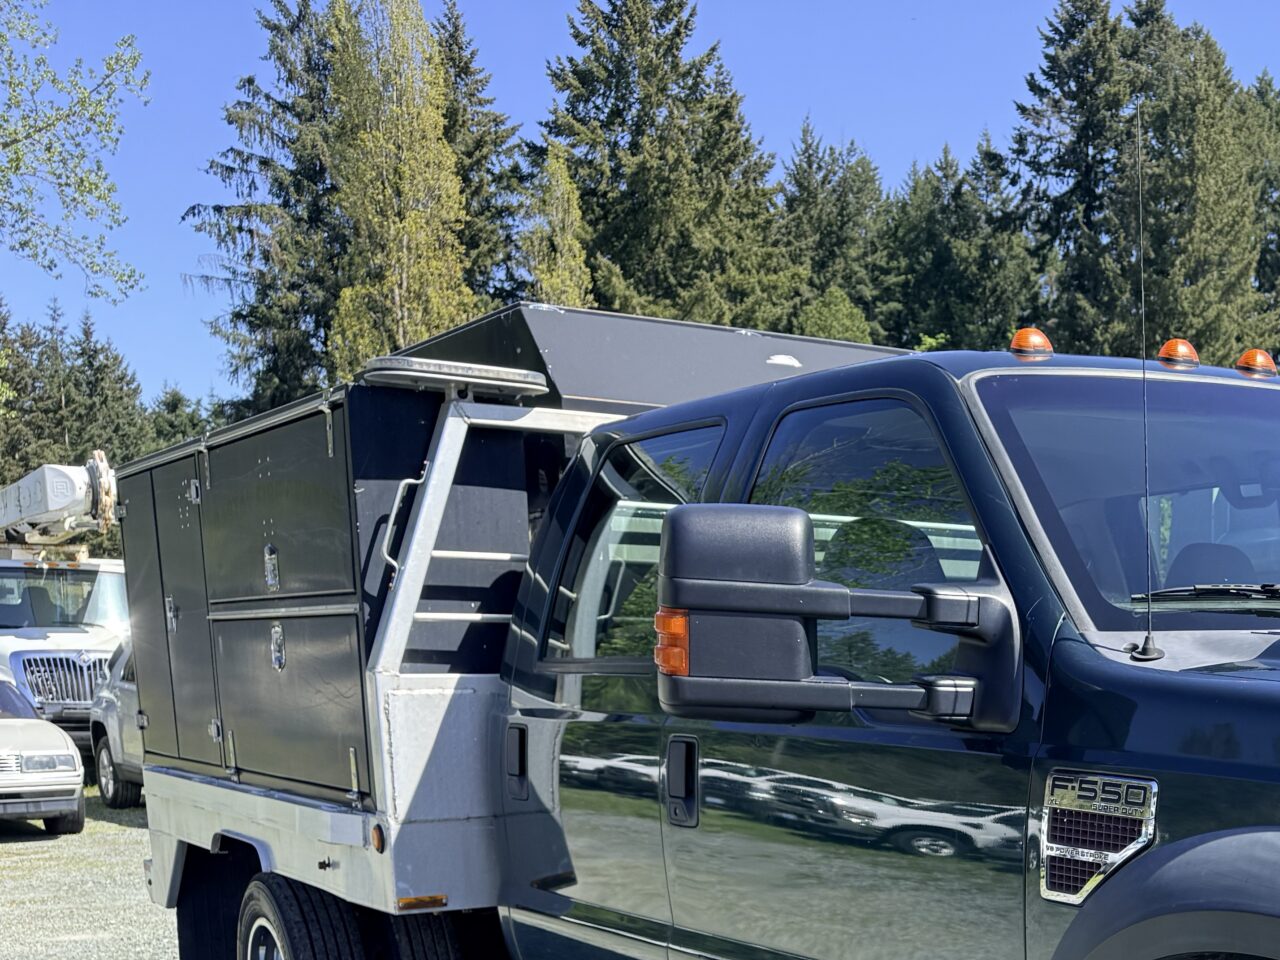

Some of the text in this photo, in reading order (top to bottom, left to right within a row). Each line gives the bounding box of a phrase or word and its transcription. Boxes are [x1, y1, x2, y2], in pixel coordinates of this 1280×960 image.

[1050, 775, 1148, 807] F-550
[1091, 804, 1145, 816] SUPER DUTY
